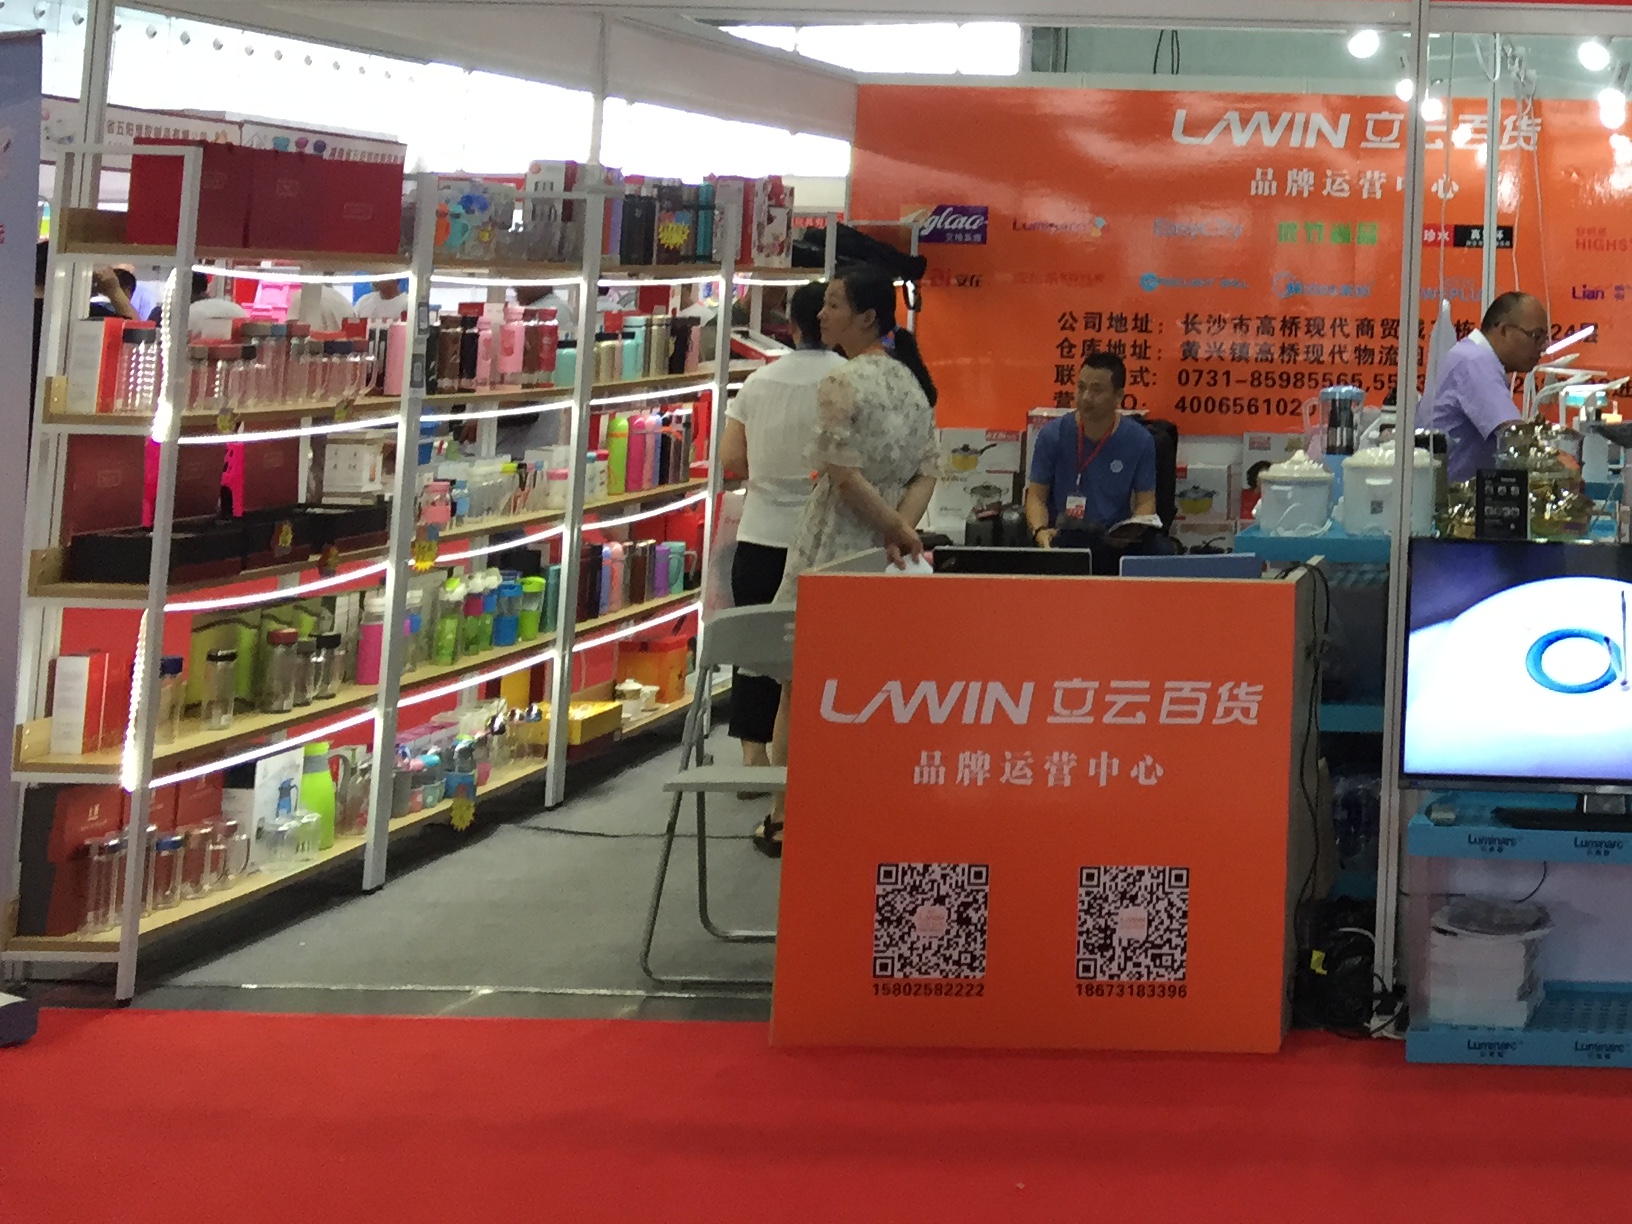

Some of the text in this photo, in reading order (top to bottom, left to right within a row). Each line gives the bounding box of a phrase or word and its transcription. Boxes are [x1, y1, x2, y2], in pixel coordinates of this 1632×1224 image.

[1171, 109, 1350, 148] LAWIN
[1250, 167, 1459, 200] 品牌运营心
[820, 678, 1264, 726] LAWIN 立云百货
[913, 749, 1166, 790] 品牌运营中心
[1574, 837, 1624, 850] Luminarc
[872, 982, 985, 997] 15802582222
[1075, 983, 1188, 999] 18673183396
